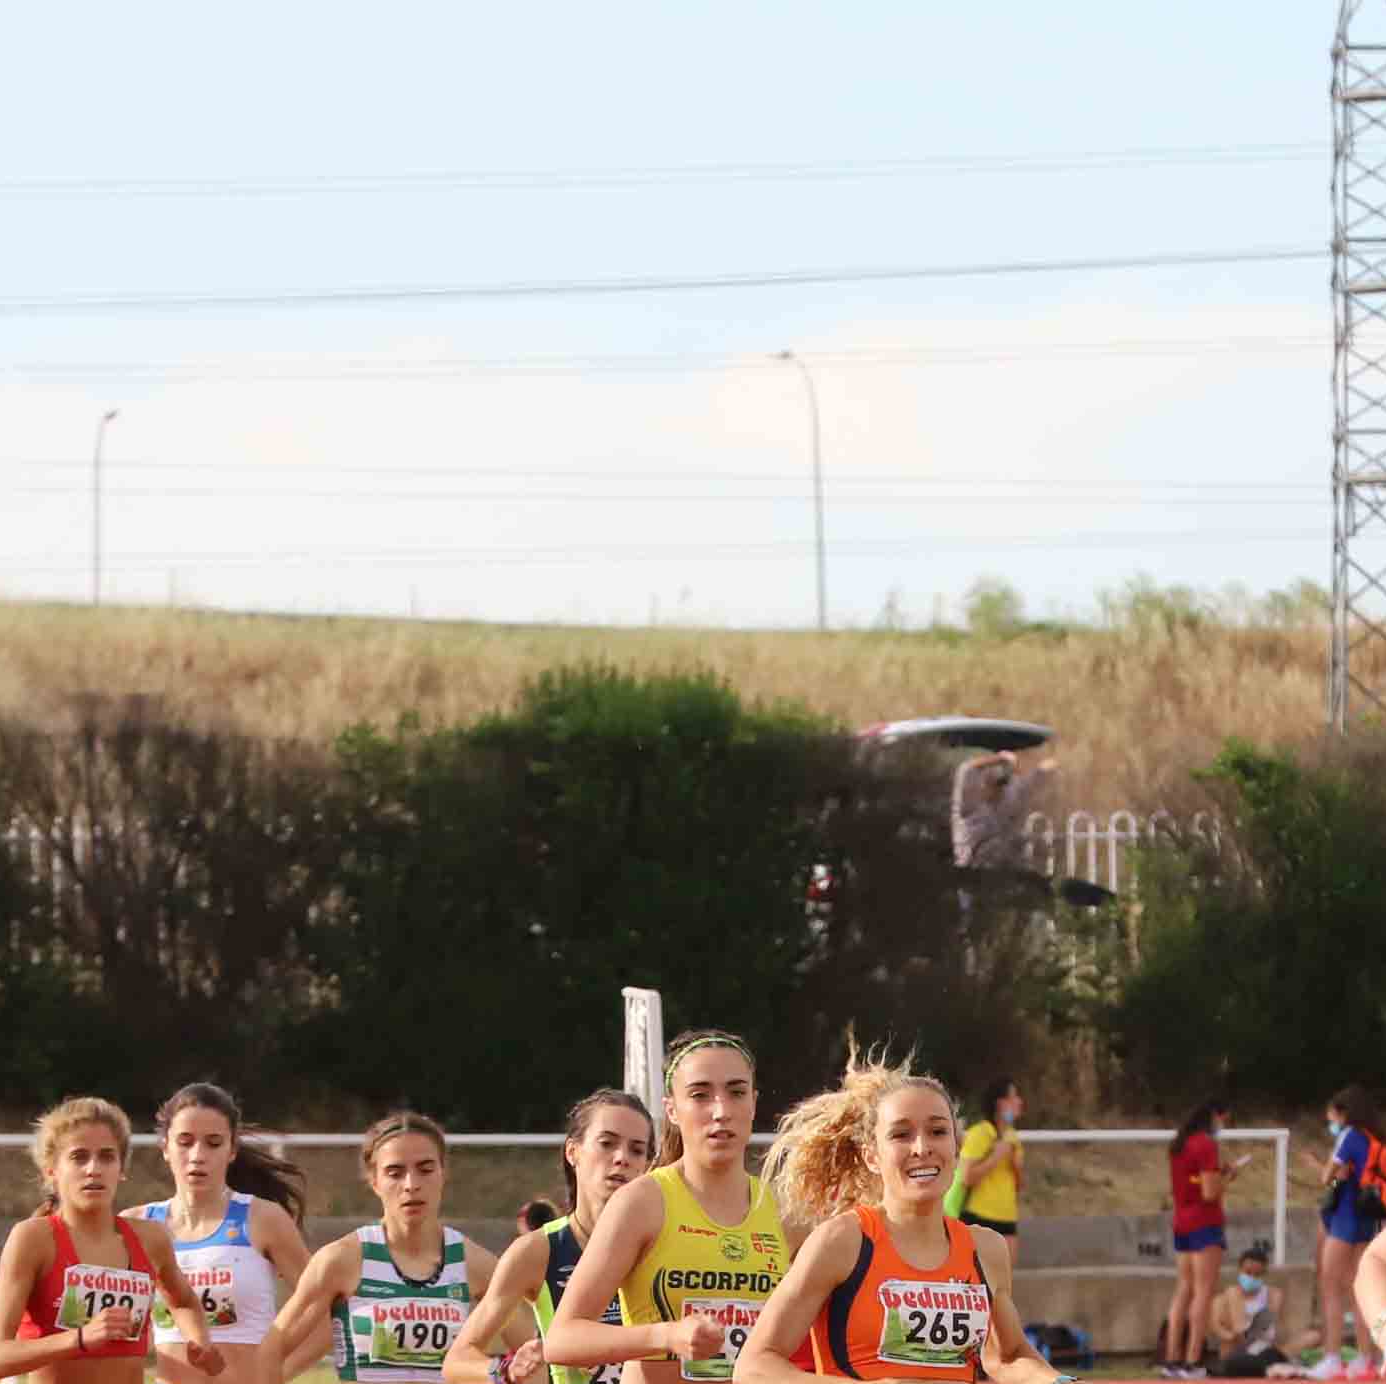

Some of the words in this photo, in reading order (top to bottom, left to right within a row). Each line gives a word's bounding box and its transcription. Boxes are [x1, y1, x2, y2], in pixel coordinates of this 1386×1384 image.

[372, 1300, 462, 1323] bedunia
[882, 1286, 988, 1312] bedunia
[394, 1322, 448, 1350] 190
[906, 1310, 970, 1346] 265
